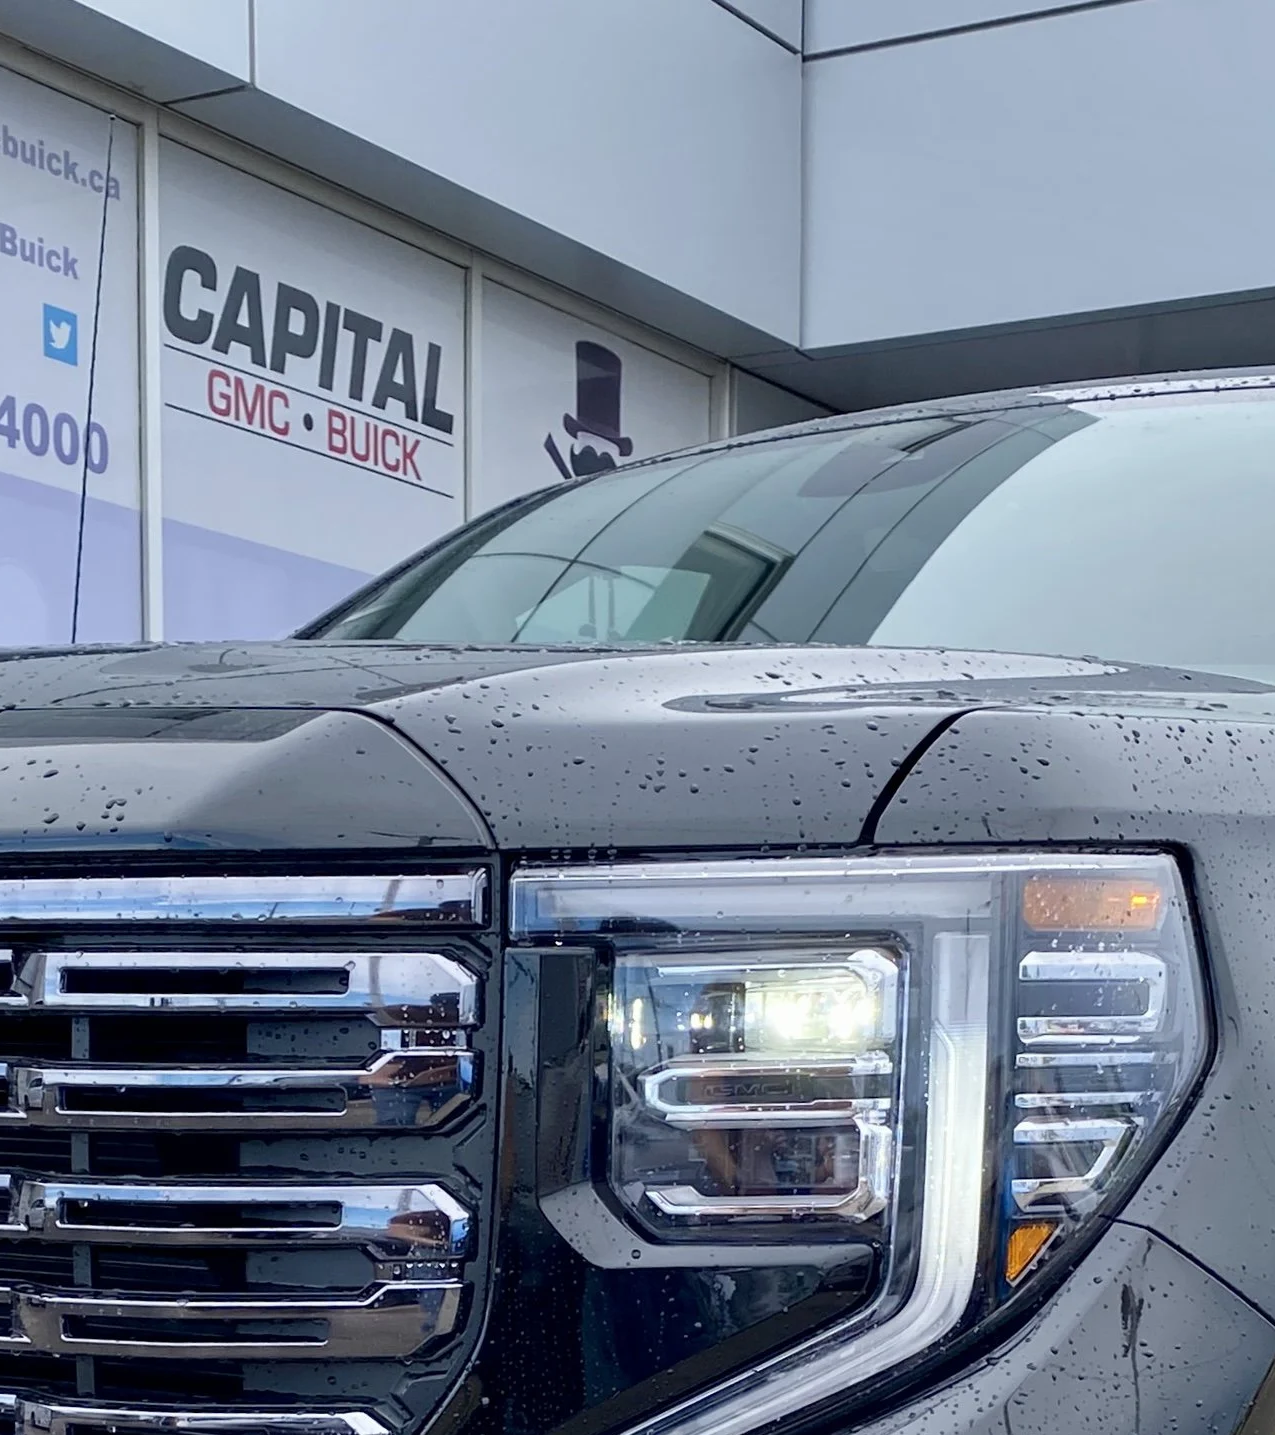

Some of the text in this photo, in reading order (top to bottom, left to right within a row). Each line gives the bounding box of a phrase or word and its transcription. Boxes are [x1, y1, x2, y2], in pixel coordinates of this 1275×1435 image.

[162, 244, 454, 435] CAPITAL
[206, 368, 423, 482] GMC BUICK
